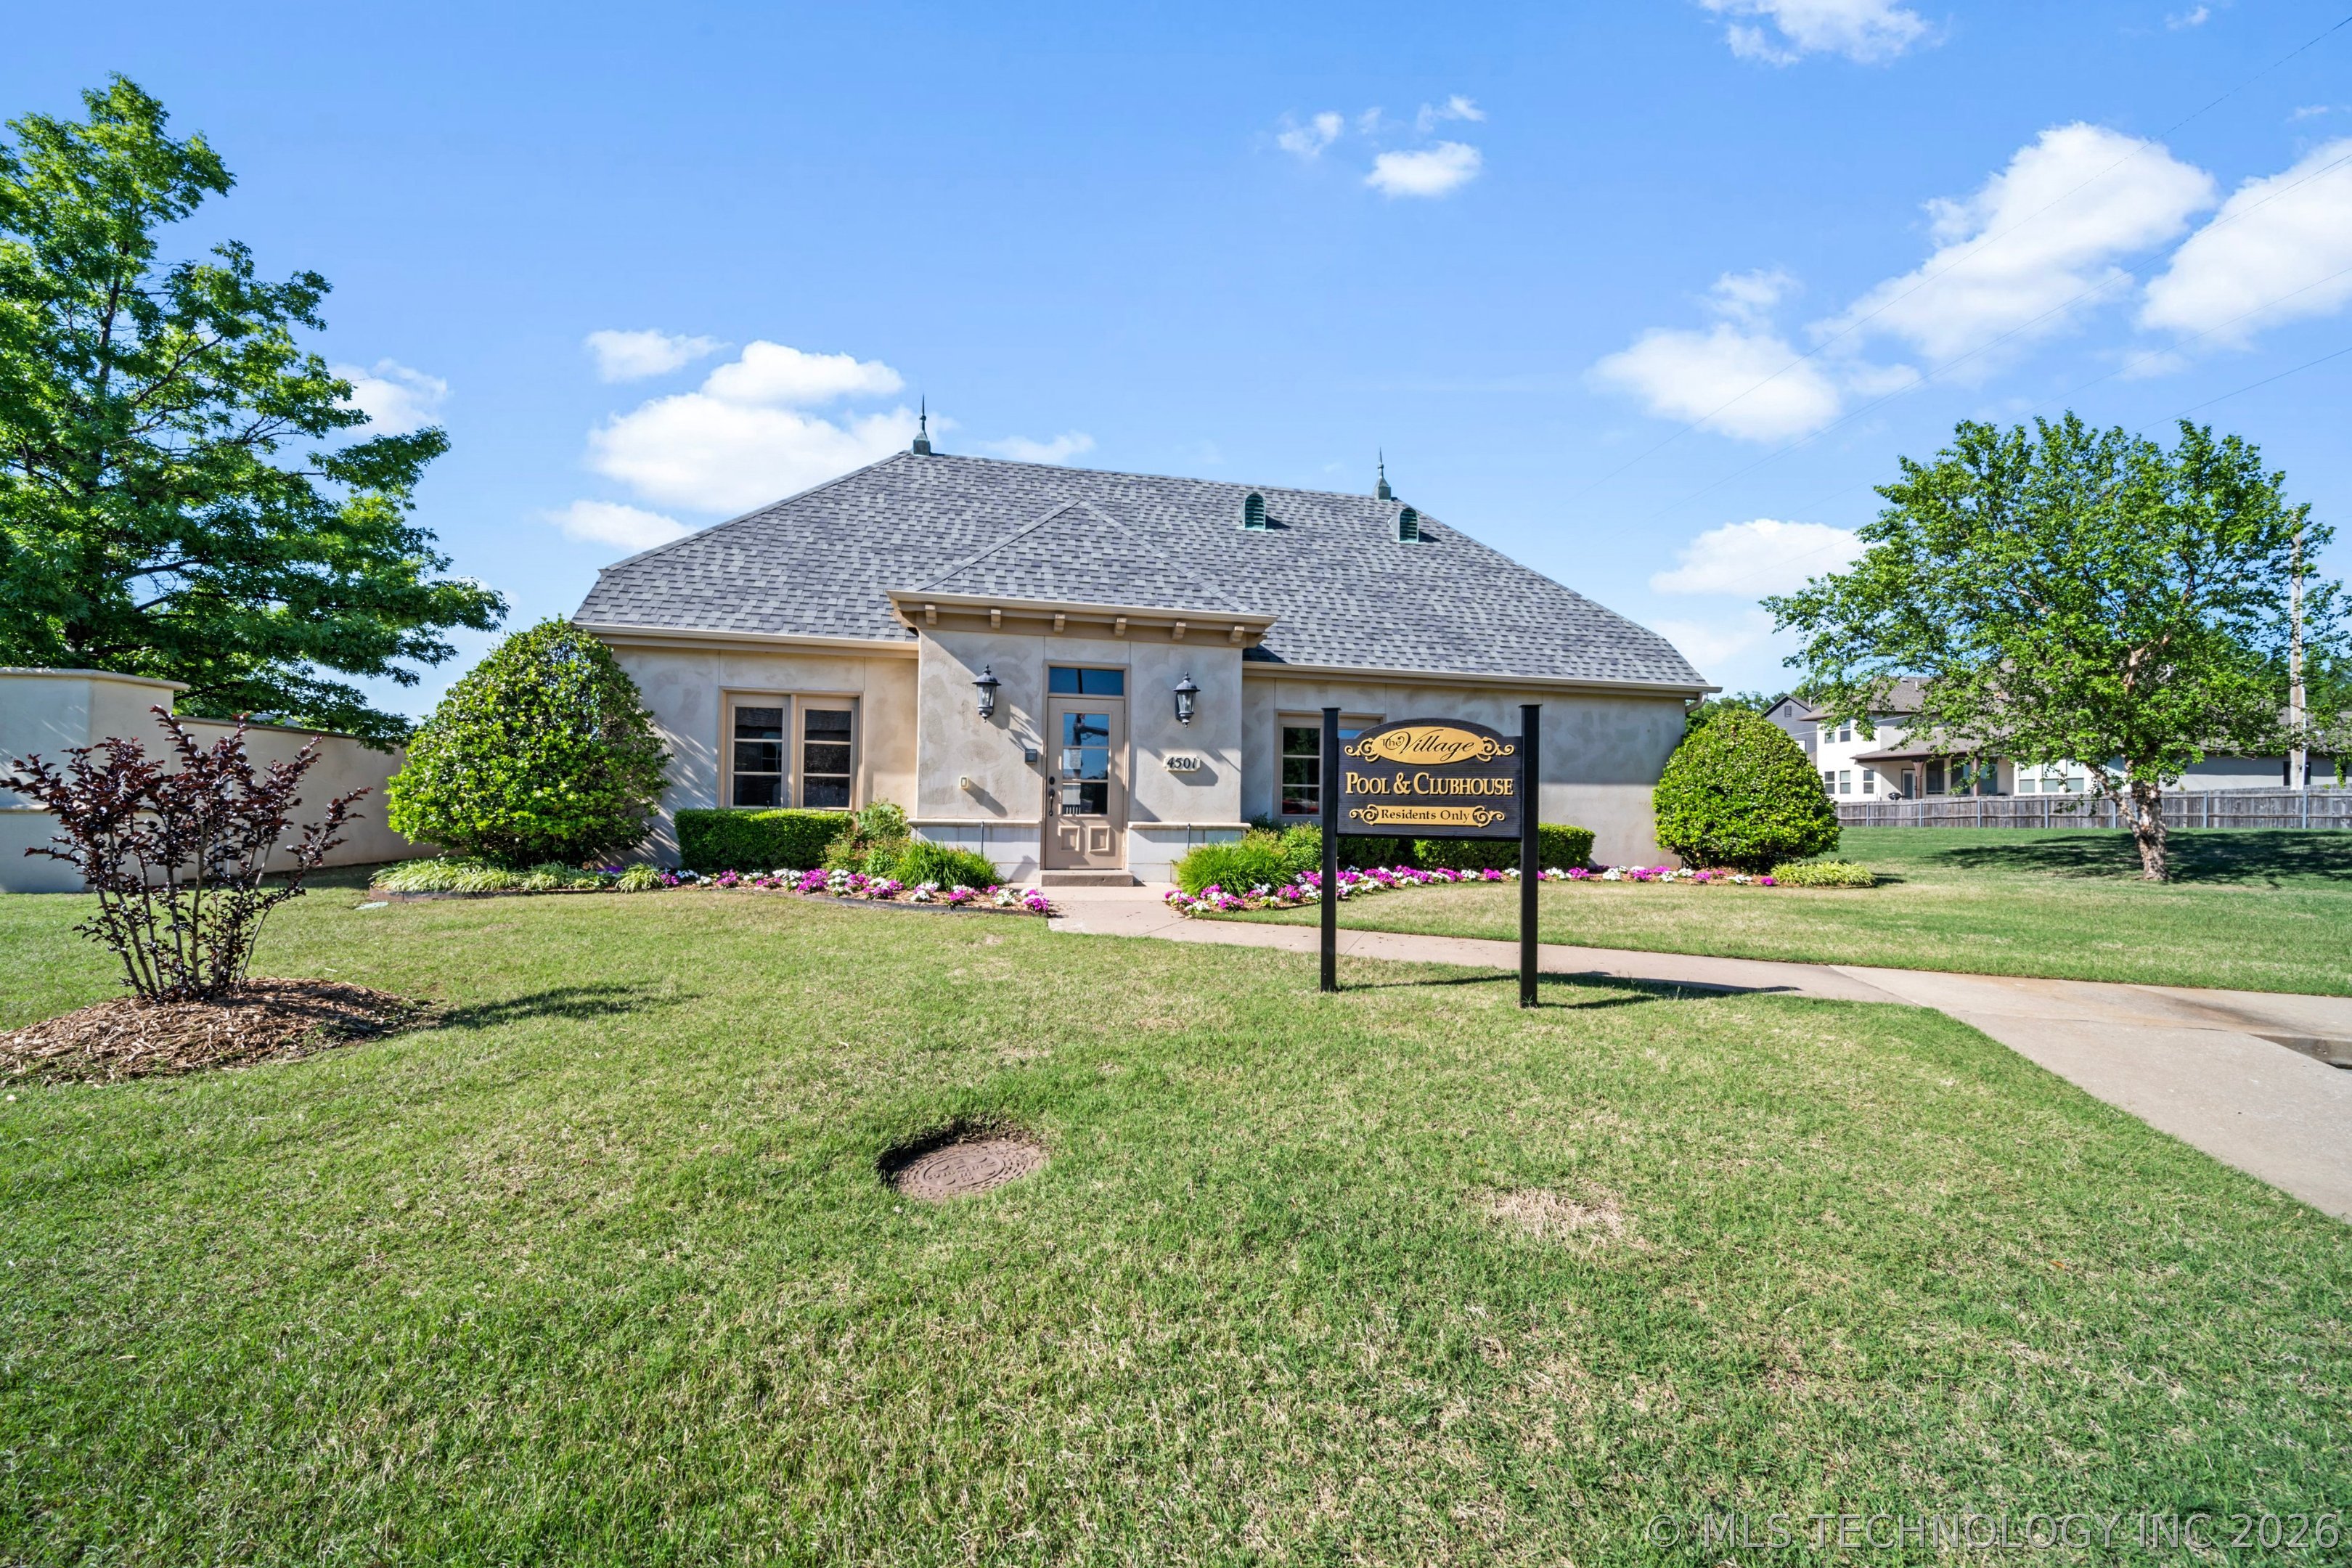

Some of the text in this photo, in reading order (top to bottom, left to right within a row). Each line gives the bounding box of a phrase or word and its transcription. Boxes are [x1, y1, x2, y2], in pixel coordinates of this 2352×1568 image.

[1380, 728, 1475, 762] The Village
[1167, 756, 1196, 769] 4501
[1345, 772, 1514, 796] POOL & CLUBHOUSE
[1381, 809, 1471, 824] Residents Only
